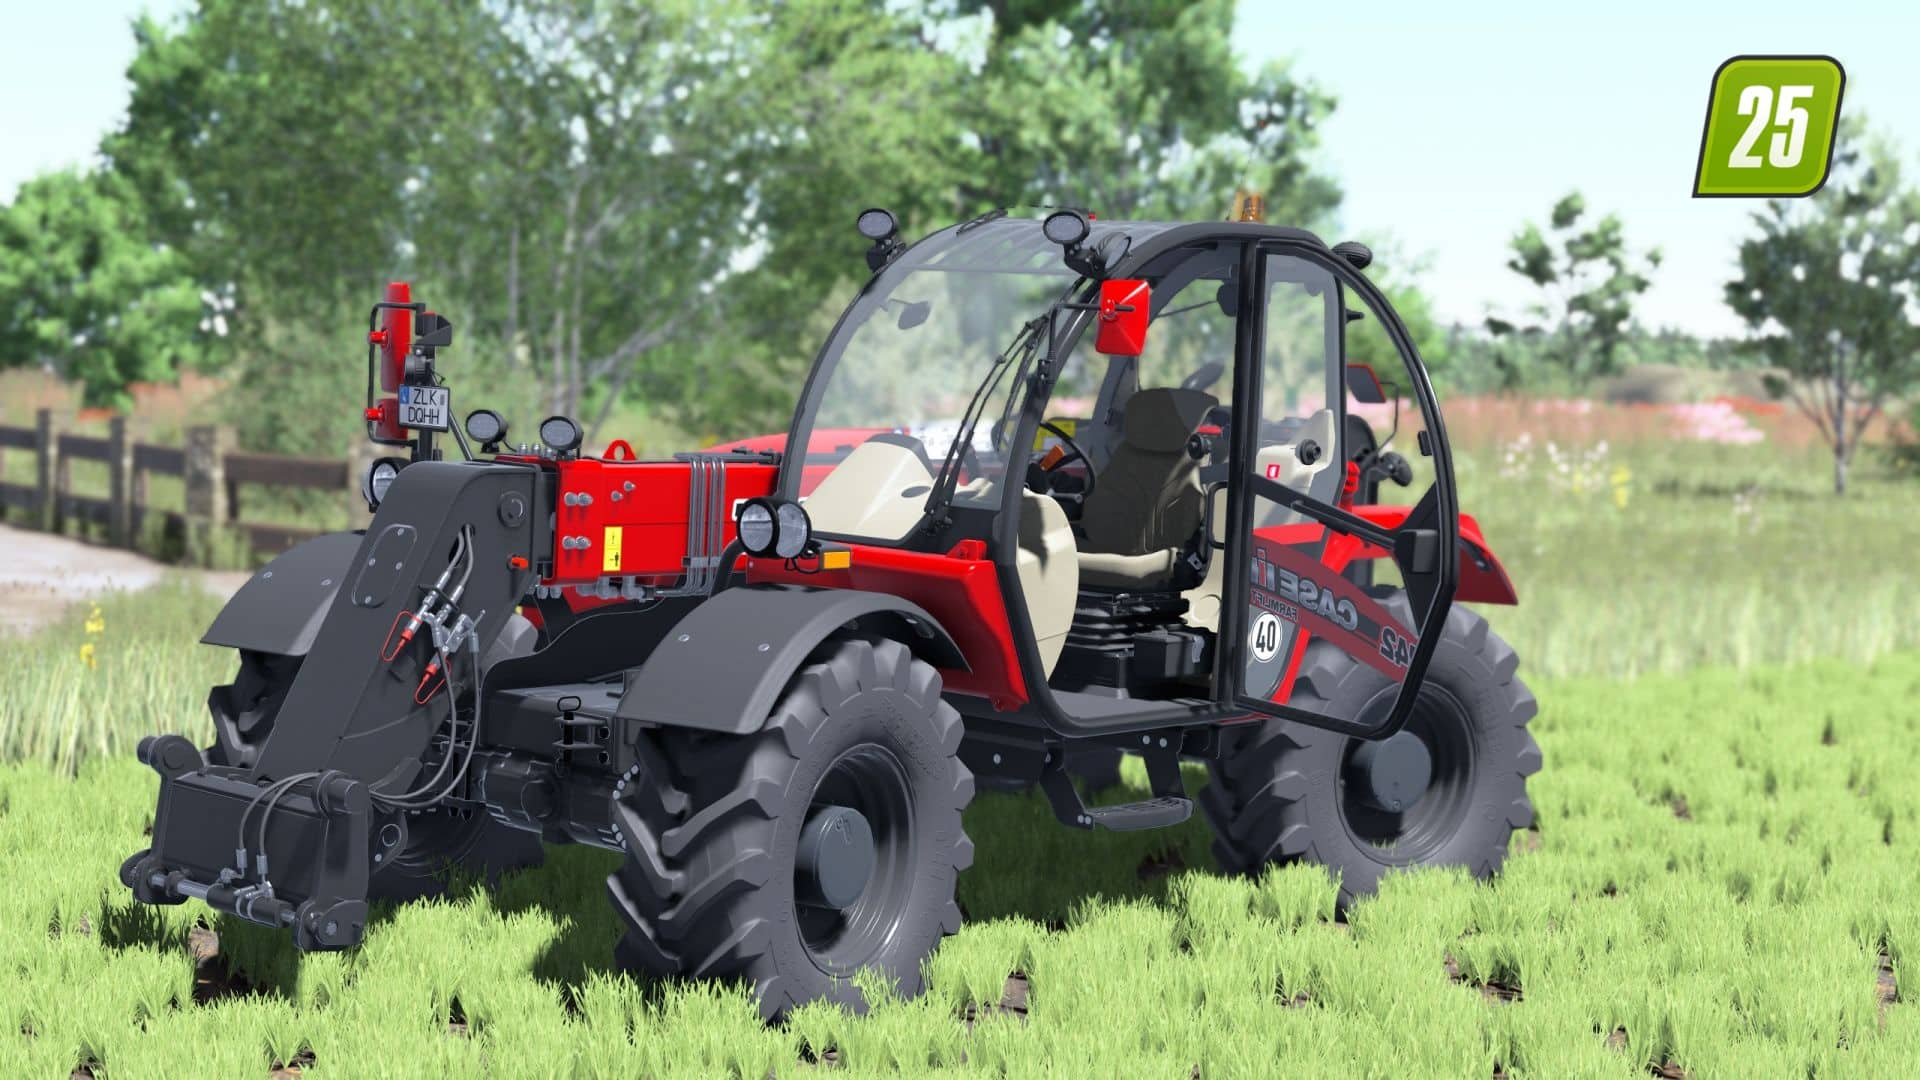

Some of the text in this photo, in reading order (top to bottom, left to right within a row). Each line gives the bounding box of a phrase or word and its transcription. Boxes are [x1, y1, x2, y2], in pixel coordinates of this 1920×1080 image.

[413, 388, 438, 406] ZLK
[408, 406, 440, 424] DQHH
[1255, 620, 1277, 654] 40
